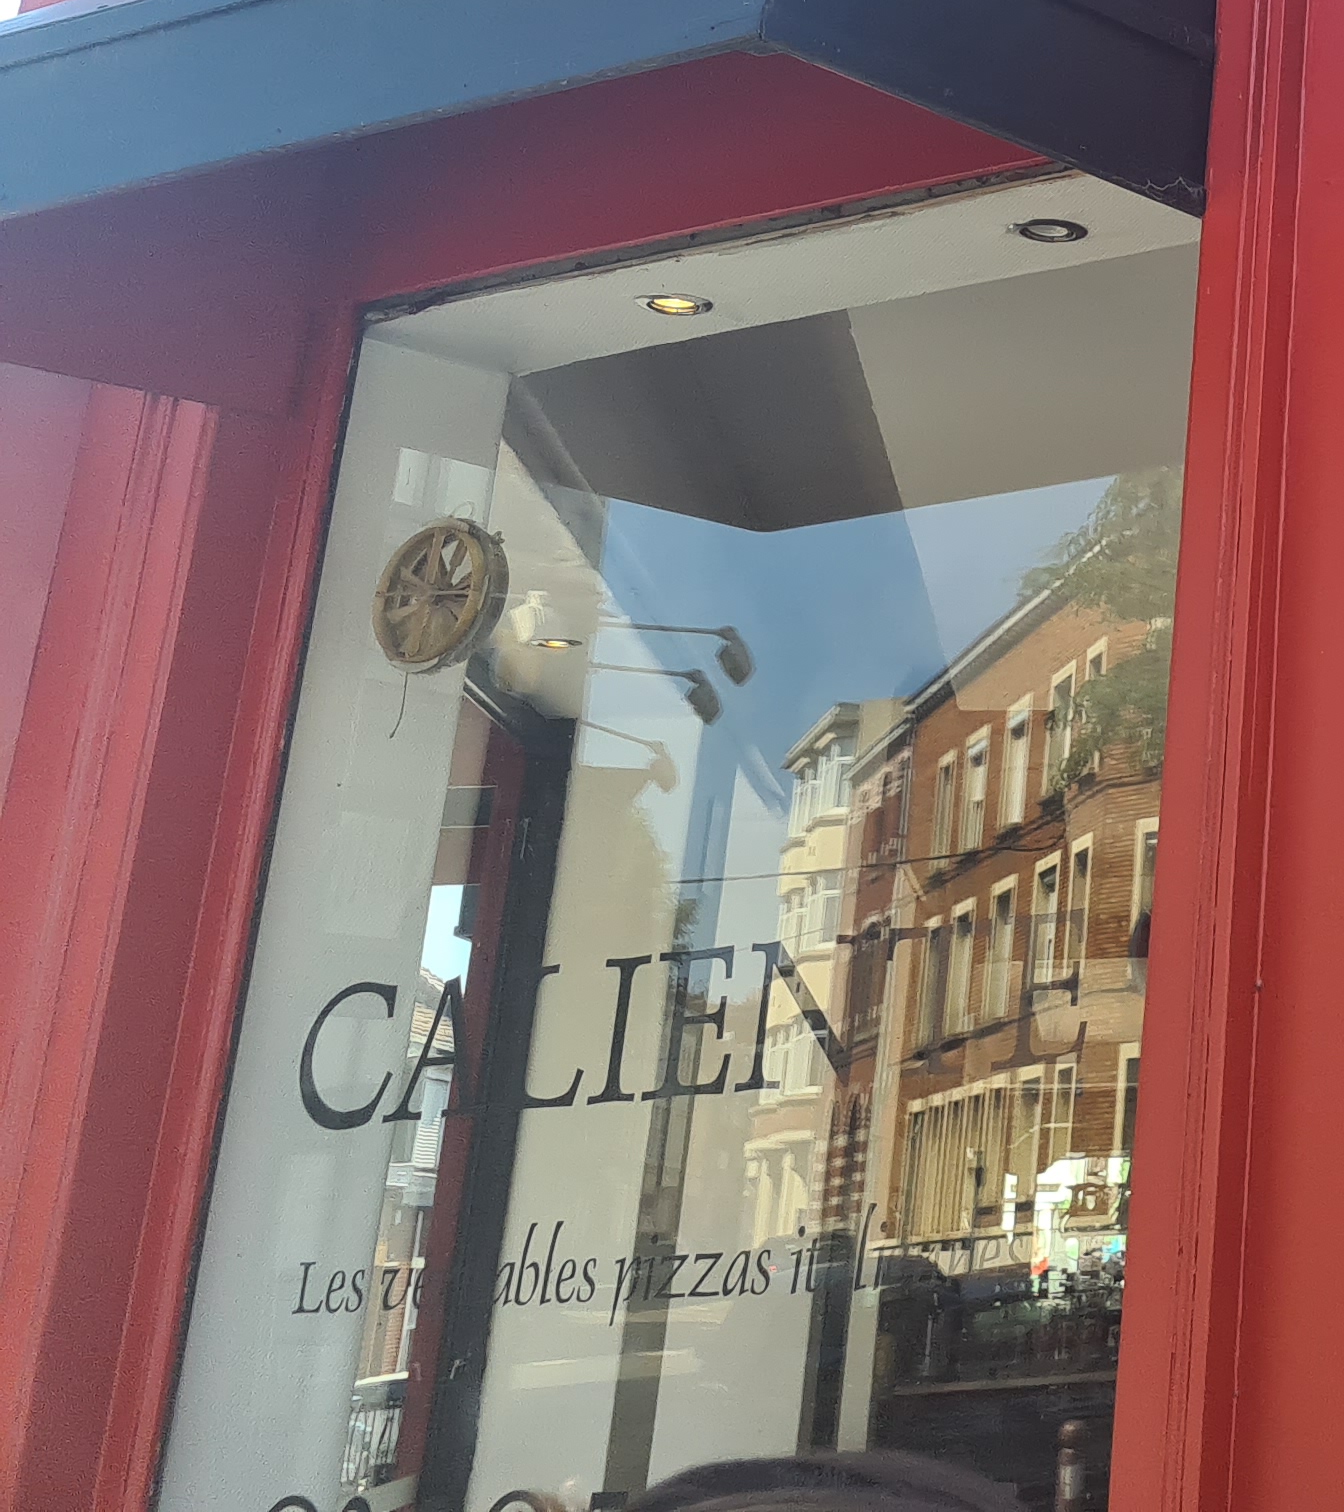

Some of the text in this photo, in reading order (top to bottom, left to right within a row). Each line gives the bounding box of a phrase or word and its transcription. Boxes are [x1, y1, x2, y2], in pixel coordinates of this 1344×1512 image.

[291, 1261, 367, 1315] Les
[381, 1220, 598, 1312] vables
[609, 1234, 773, 1326] pizzas
